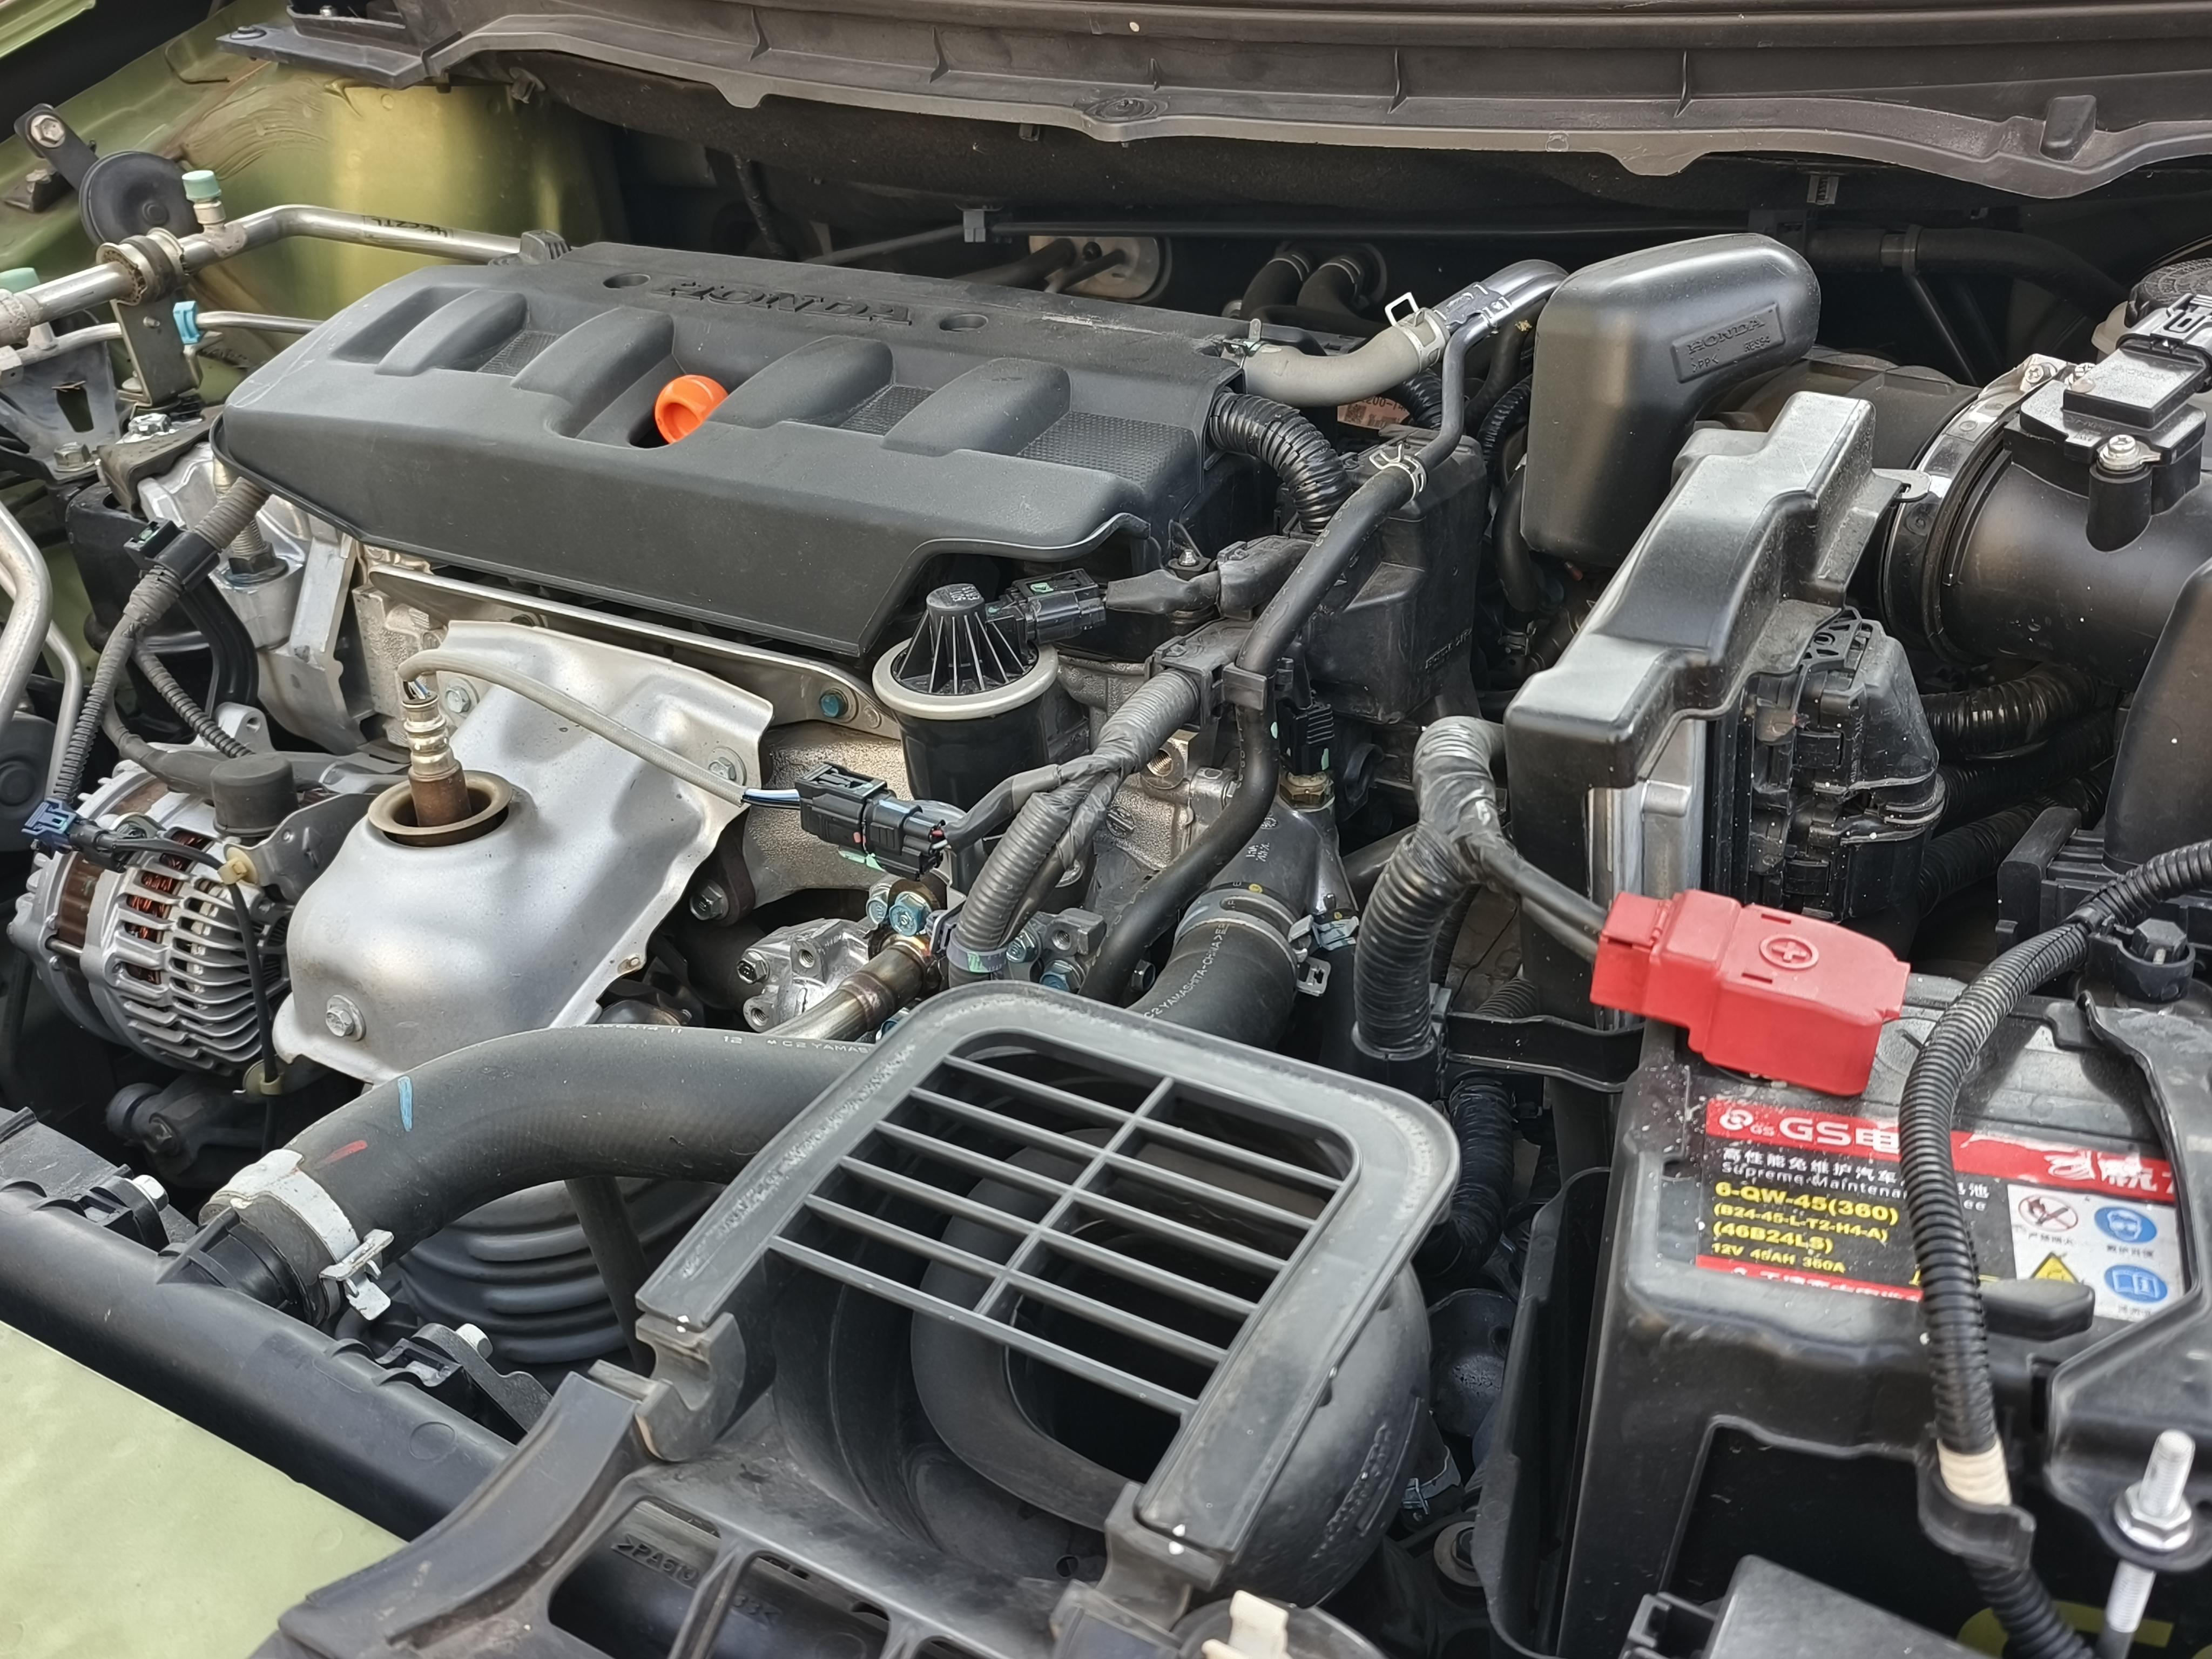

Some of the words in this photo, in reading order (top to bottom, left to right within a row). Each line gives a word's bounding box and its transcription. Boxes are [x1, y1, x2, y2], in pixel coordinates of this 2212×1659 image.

[652, 282, 913, 326] HONDA
[1687, 318, 1765, 354] HONDA
[723, 1035, 744, 1045] 12
[811, 1042, 872, 1054] YAMAS
[1750, 1124, 1776, 1137] GS
[1816, 1176, 1907, 1201] Maintena
[1715, 1181, 1899, 1226] 6-QW-45(360)
[1711, 1242, 1744, 1257] 12V
[1712, 1220, 1834, 1254] (46B24LS)
